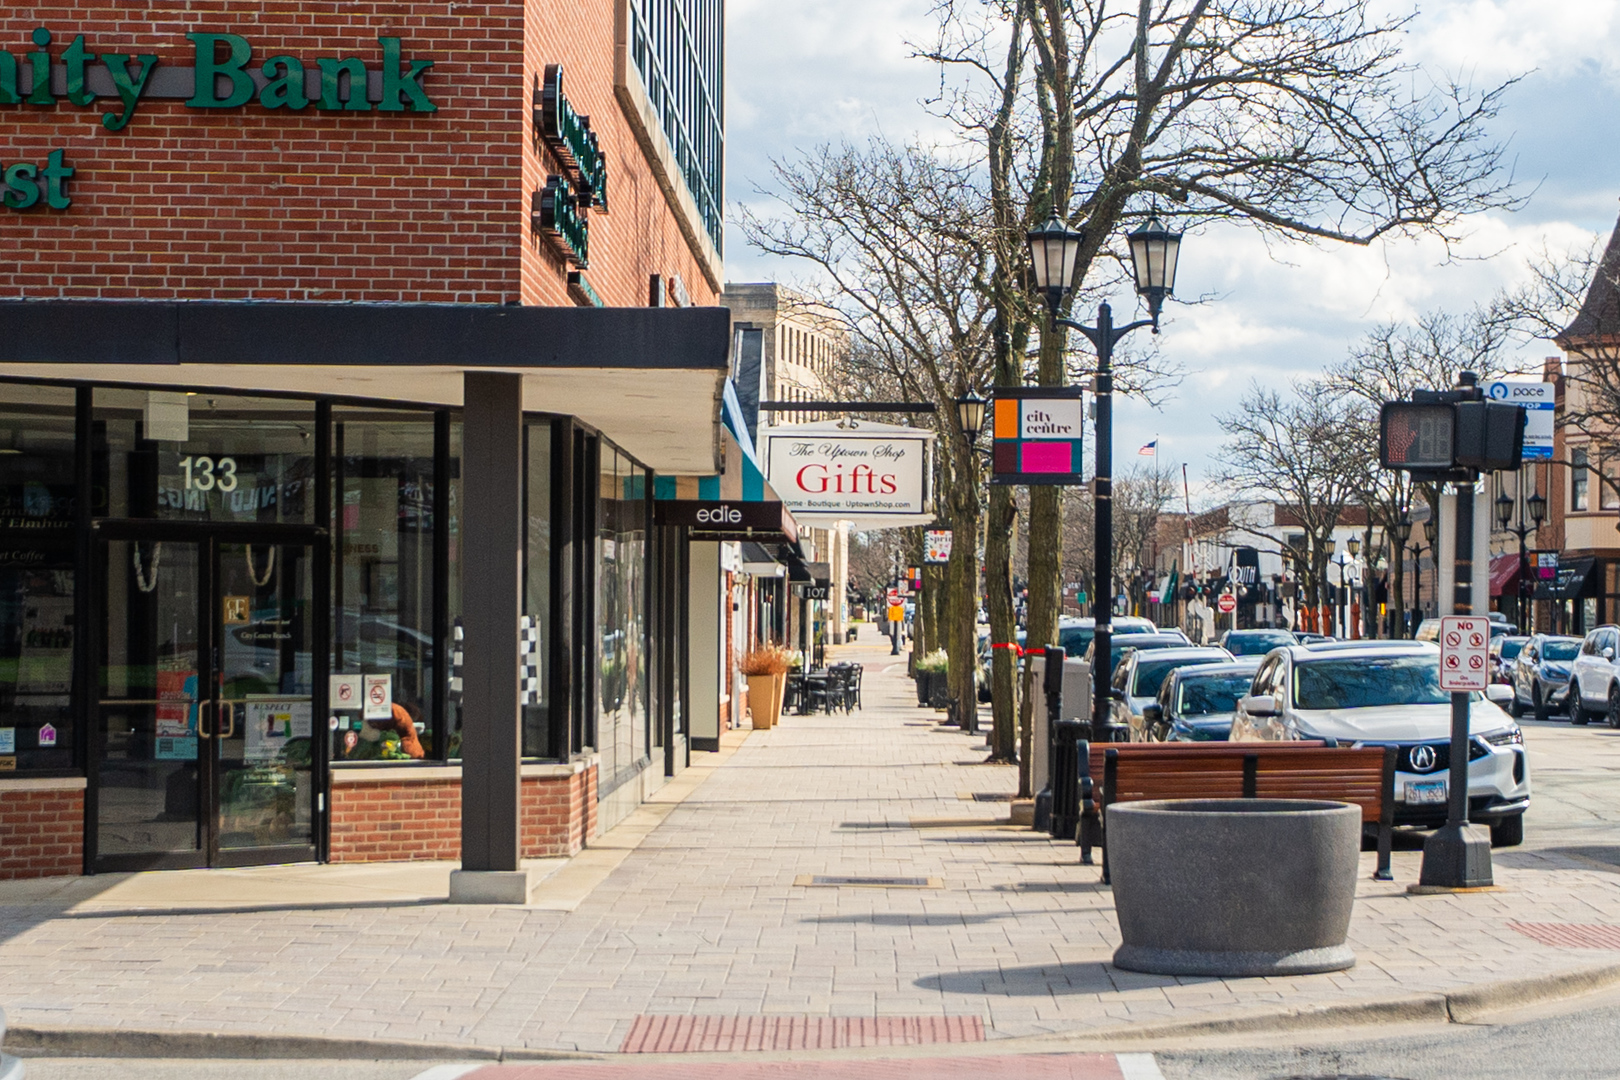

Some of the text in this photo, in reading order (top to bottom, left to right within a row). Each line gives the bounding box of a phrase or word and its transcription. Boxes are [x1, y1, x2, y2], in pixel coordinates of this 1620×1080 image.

[184, 31, 438, 113] Bank
[1513, 388, 1544, 397] pace
[1026, 410, 1052, 426] city
[1026, 422, 1072, 434] centre
[789, 442, 906, 461] The Uptown Shop
[178, 456, 238, 491] 133
[796, 463, 897, 494] Gifts
[807, 499, 841, 508] Boutique
[845, 500, 911, 509] UptownShop.com
[696, 504, 742, 523] edie
[8, 518, 76, 528] Elmhur
[12, 550, 46, 563] Coffee
[806, 587, 825, 599] 107
[1457, 622, 1474, 630] NO
